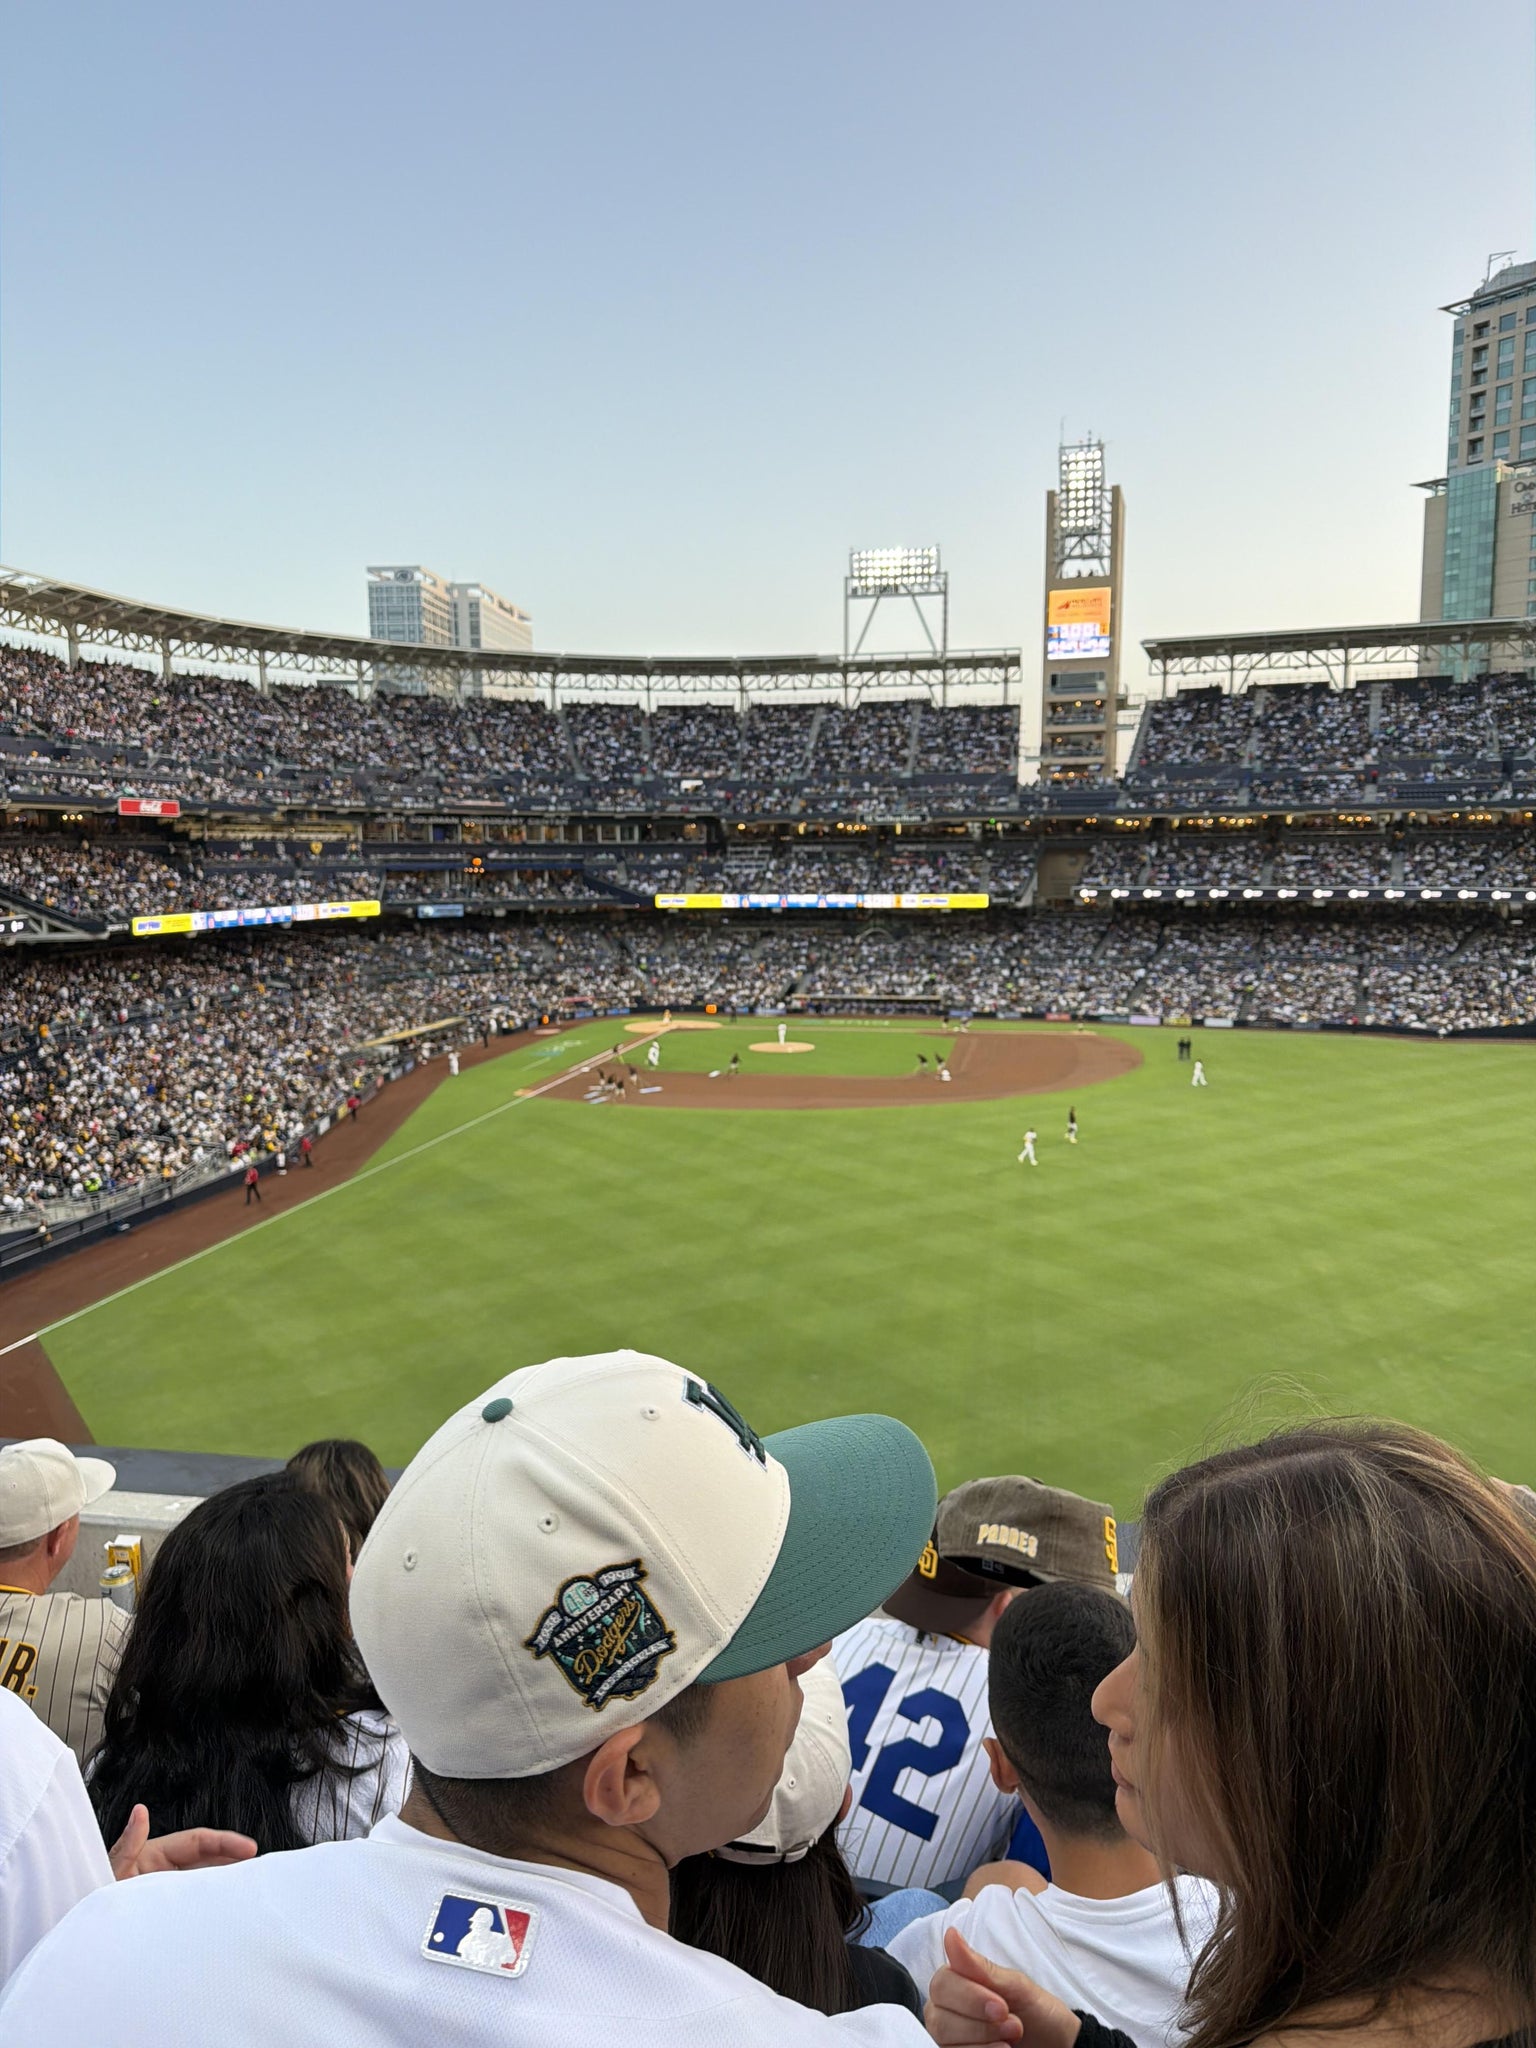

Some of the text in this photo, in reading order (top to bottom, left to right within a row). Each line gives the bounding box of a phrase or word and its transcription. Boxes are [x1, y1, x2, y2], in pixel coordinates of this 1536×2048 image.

[976, 1524, 1038, 1558] PADRES
[553, 1582, 631, 1647] ANNIVERSARY
[574, 1598, 641, 1684] Dodgers
[0, 1637, 39, 1698] R.
[596, 1639, 668, 1699] LOS ANGELES
[841, 1661, 970, 1842] 42
